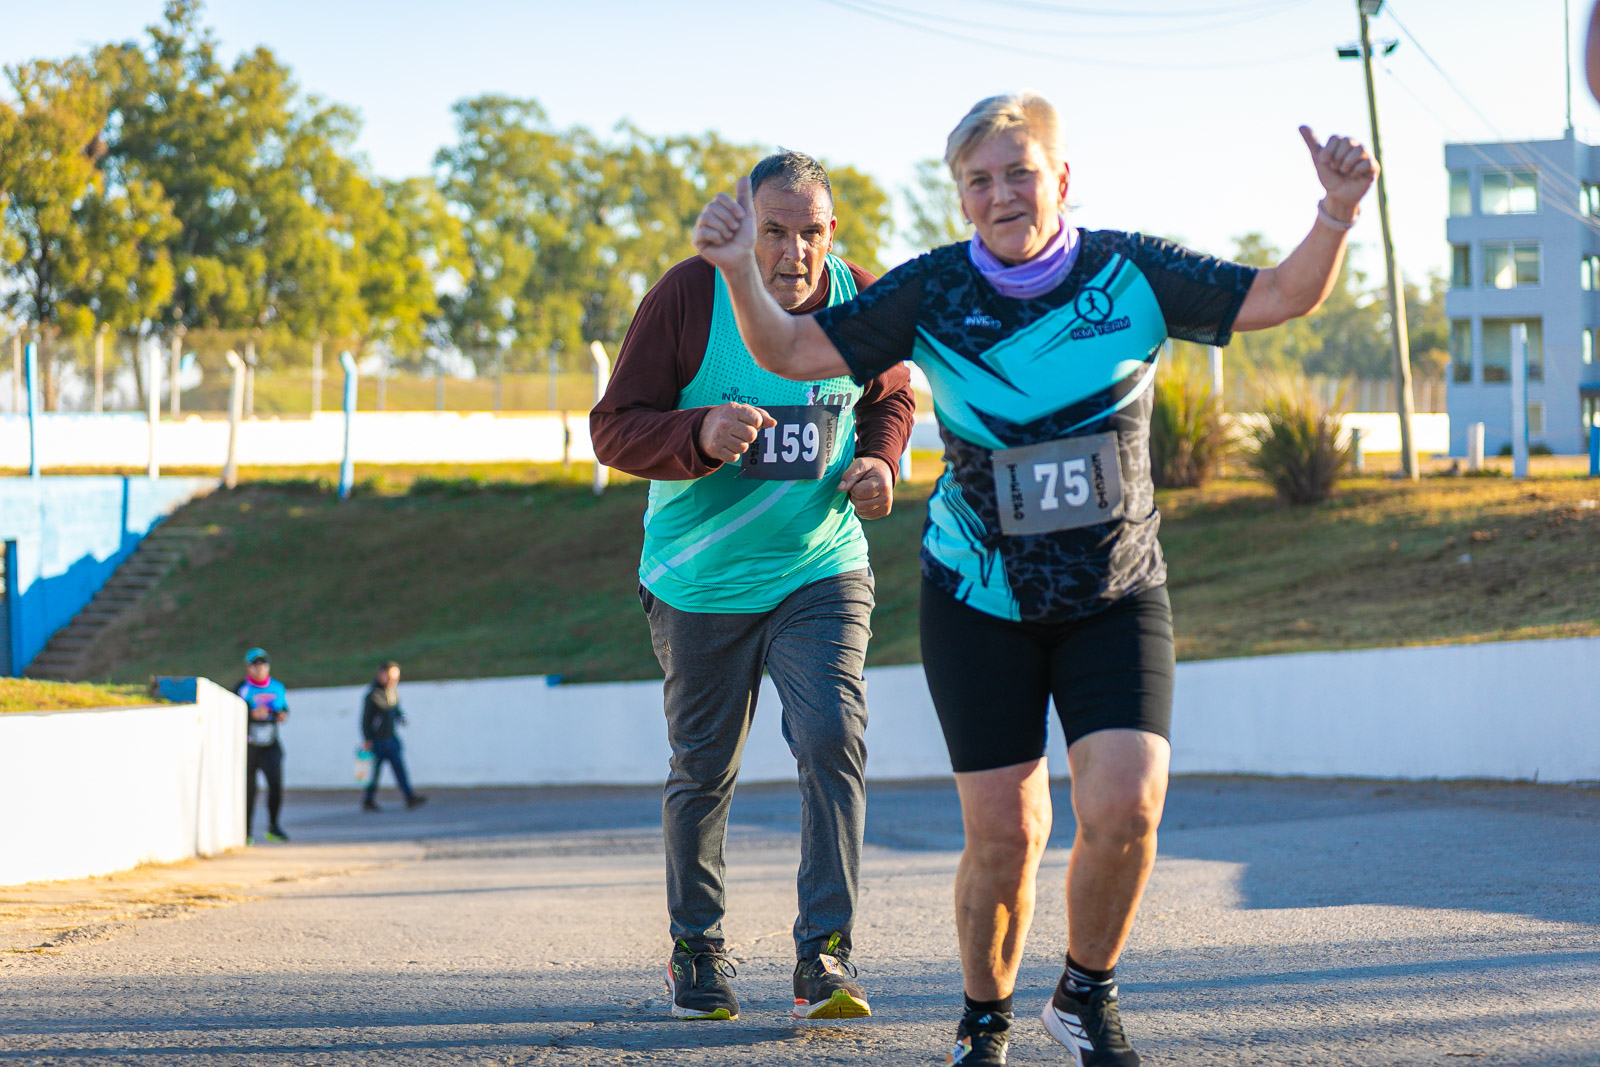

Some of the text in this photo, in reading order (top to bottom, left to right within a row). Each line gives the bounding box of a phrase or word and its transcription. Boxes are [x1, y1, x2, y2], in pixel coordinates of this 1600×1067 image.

[1071, 316, 1131, 340] KM TEAM
[721, 392, 759, 405] INVICTO
[812, 385, 852, 406] km
[763, 422, 820, 463] 159
[825, 418, 833, 464] EXACTO
[1007, 463, 1025, 520] TIEMPO
[1034, 458, 1090, 511] 75
[1091, 452, 1109, 509] EXACTO
